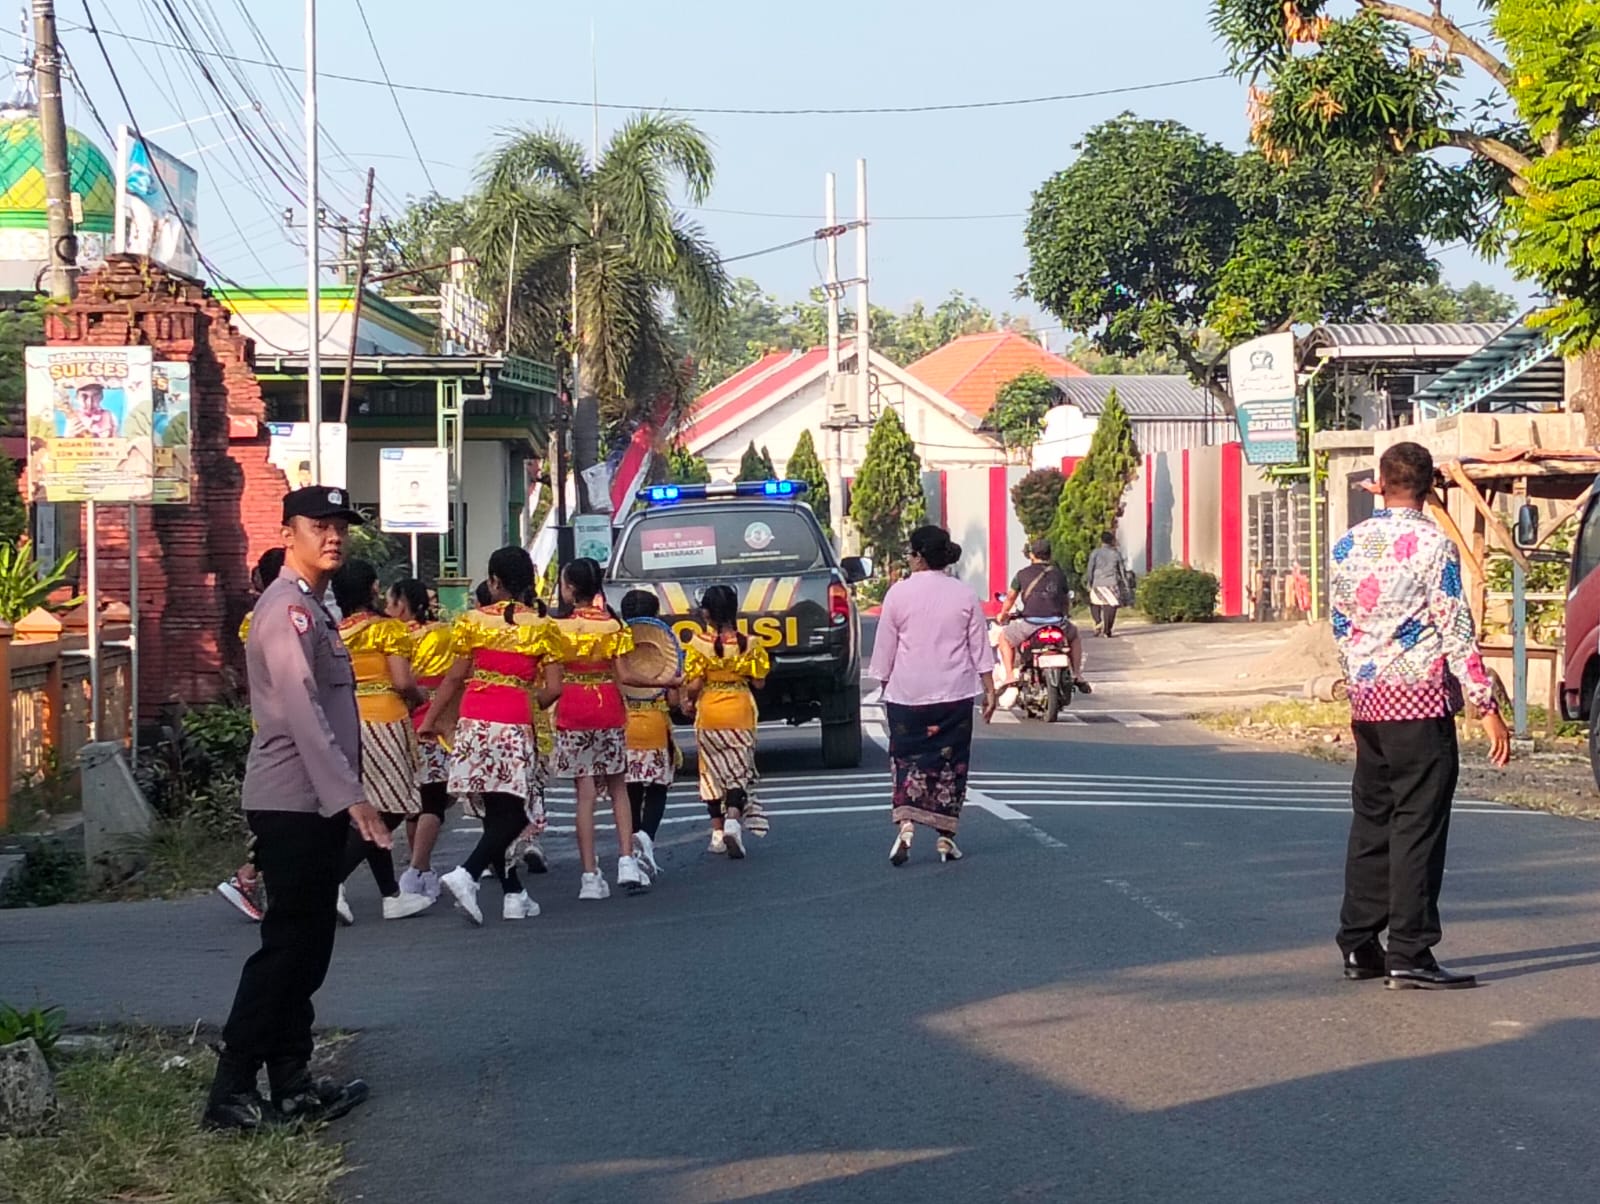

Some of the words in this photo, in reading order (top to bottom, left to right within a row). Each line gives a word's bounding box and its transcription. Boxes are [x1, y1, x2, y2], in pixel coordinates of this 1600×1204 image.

[49, 361, 129, 380] SUKSES
[677, 540, 704, 549] UNTUK
[654, 549, 704, 559] MASYARAKAT
[669, 617, 799, 648] OISI
